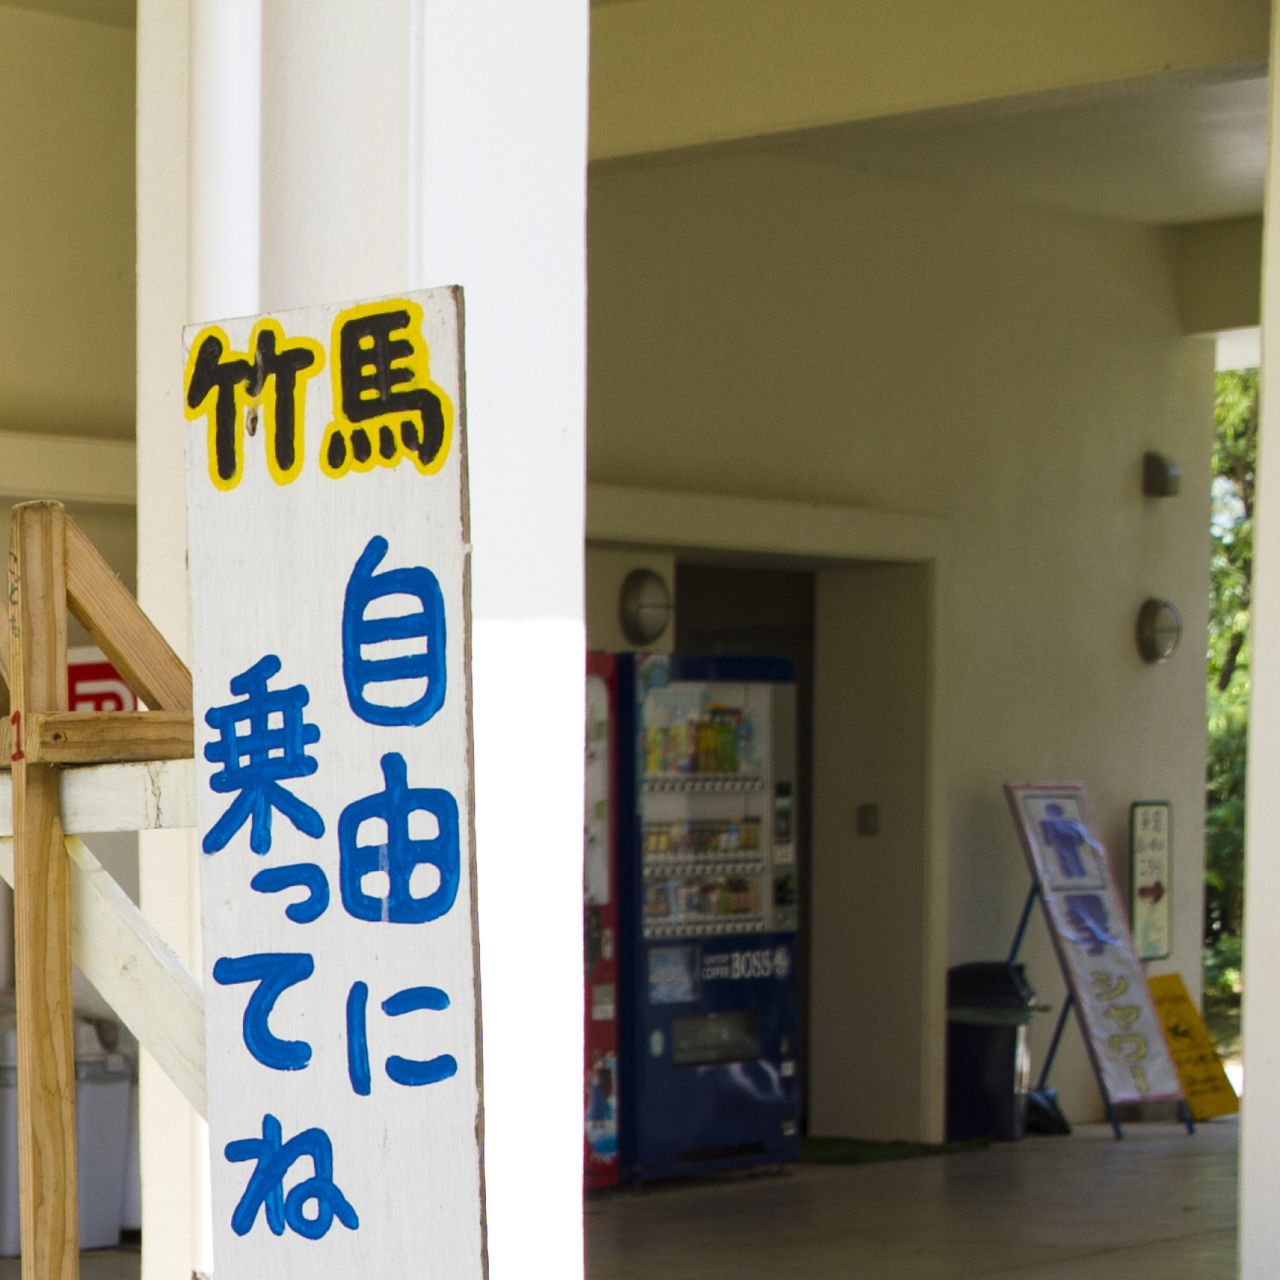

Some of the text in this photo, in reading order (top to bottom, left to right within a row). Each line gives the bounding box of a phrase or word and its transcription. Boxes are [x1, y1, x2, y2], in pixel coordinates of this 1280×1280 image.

[185, 300, 452, 490] 竹馬
[10, 710, 25, 762] 1
[338, 535, 459, 1096] 自由に
[202, 654, 359, 1240] 乗ってね
[731, 950, 771, 980] BOSS
[1090, 969, 1149, 1095] シャワー
